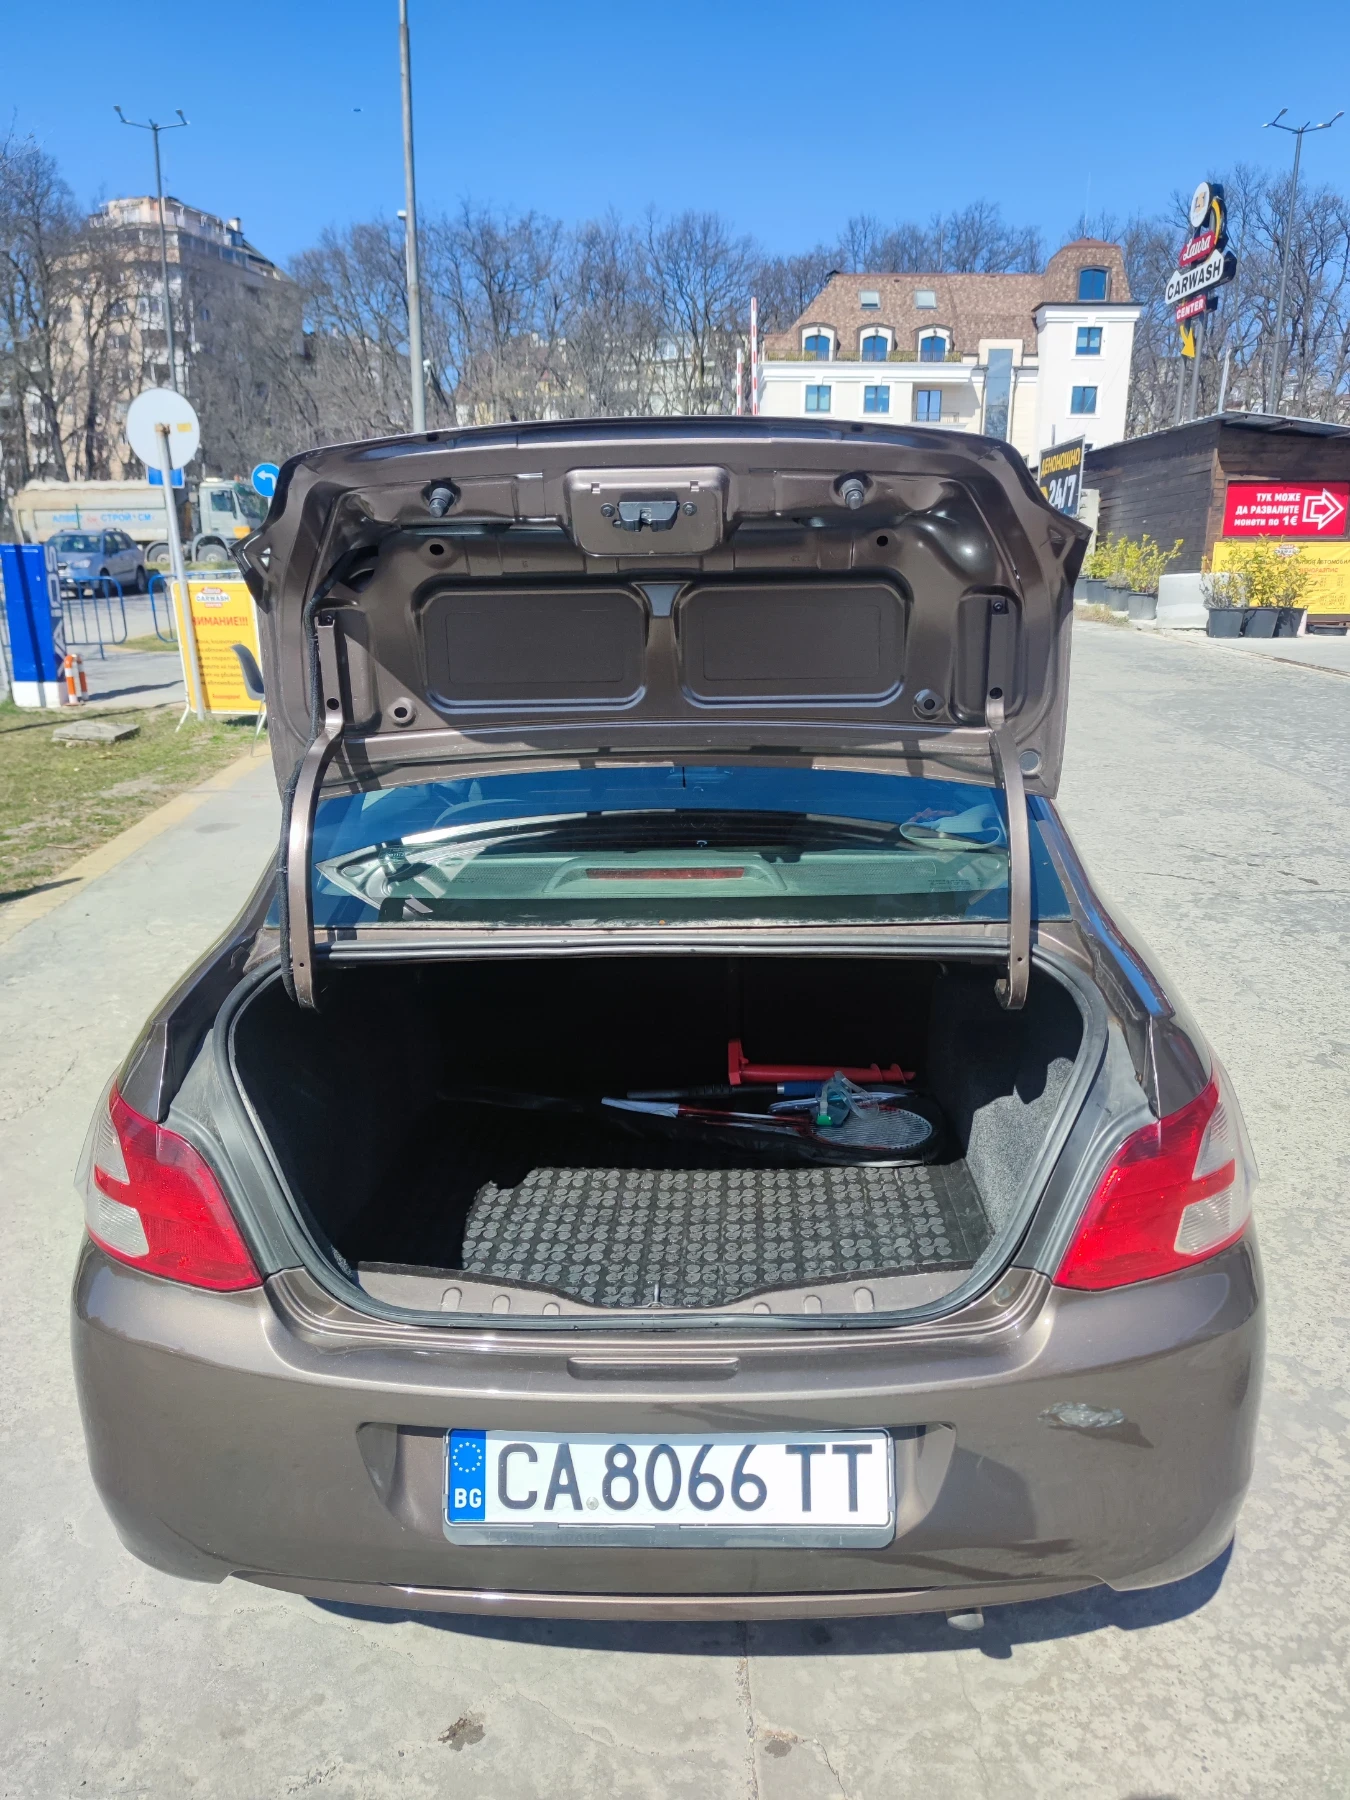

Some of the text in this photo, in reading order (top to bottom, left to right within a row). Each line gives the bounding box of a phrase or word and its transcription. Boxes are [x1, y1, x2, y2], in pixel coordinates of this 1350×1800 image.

[1183, 234, 1212, 261] Laura
[1167, 259, 1222, 301] CARWASH
[1176, 299, 1204, 320] CENTER
[1041, 447, 1081, 478] ДЕНОНОЩНО
[1048, 474, 1077, 509] 24/7
[1256, 493, 1301, 502] ТУК МОЖЕ
[1234, 515, 1298, 526] монети по 1€
[1235, 505, 1299, 515] ДА РАЗВАЛИТЕ
[191, 616, 248, 626] НИМАНИЕ!!!
[454, 1487, 482, 1509] BG
